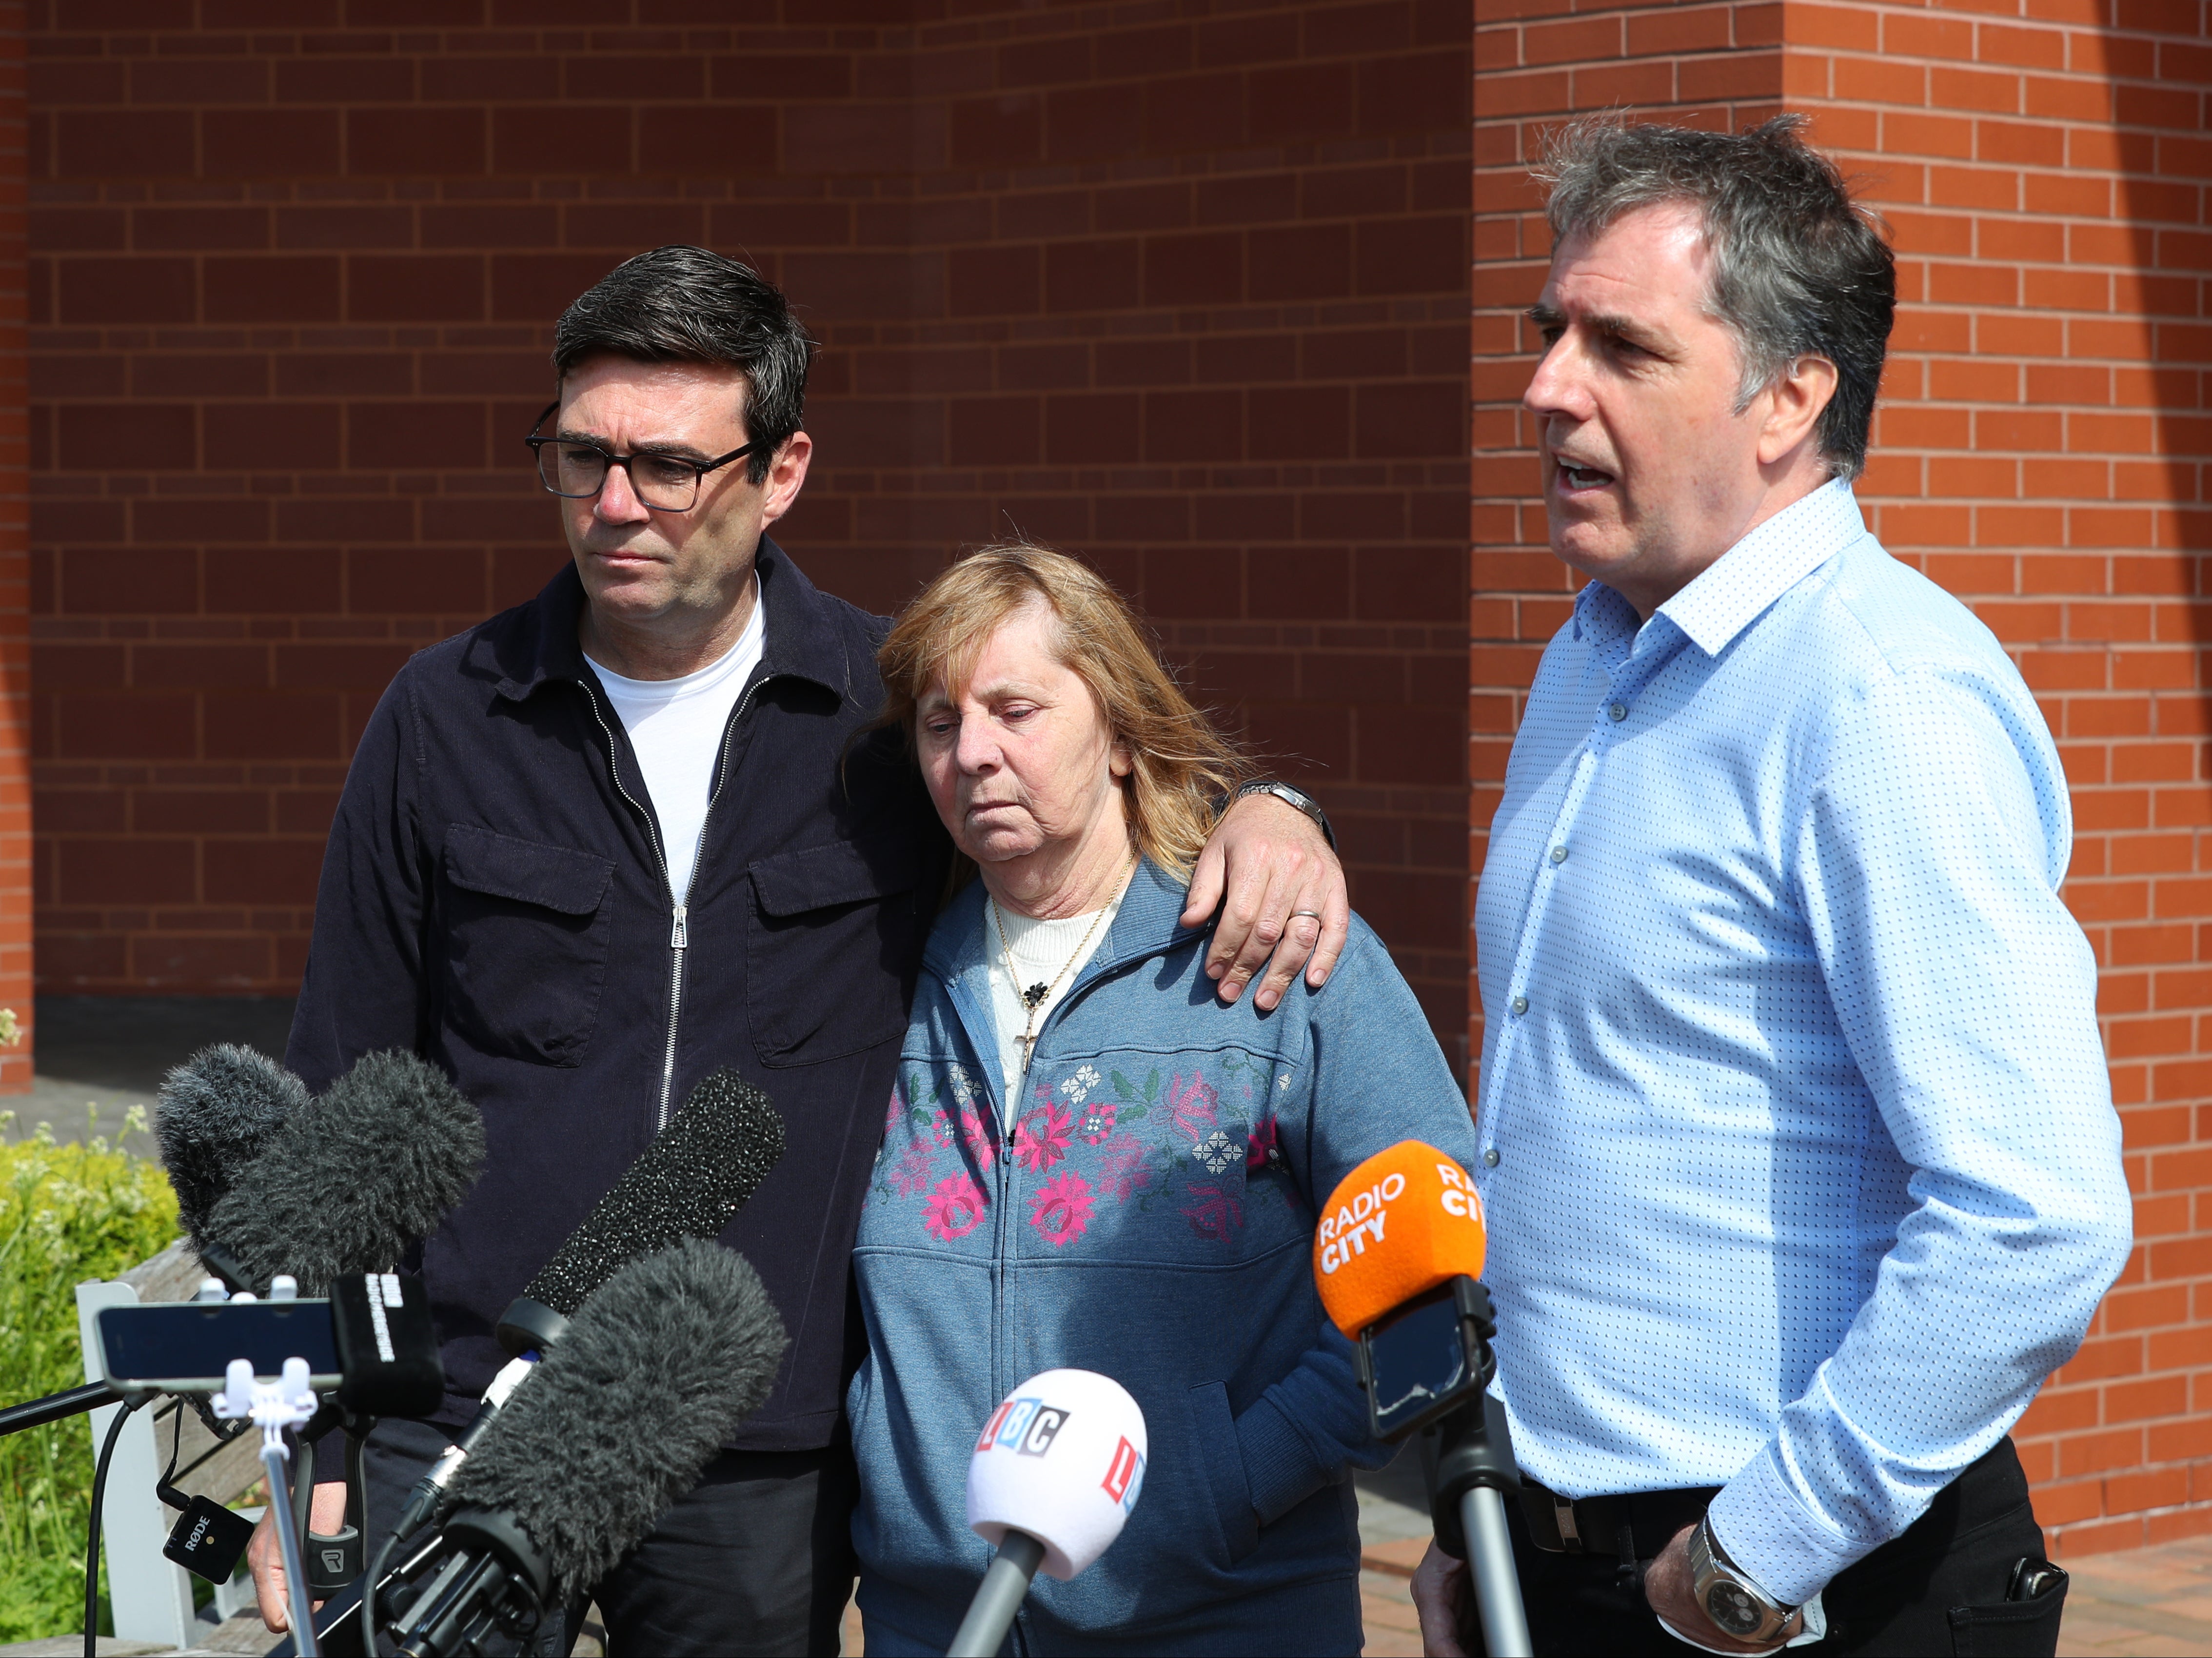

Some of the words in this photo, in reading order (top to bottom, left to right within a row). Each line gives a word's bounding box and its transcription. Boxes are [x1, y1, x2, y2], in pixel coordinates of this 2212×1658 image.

[1320, 1173, 1405, 1247] RADIO
[1321, 1210, 1386, 1275] CITY
[980, 1401, 1062, 1454] LBC
[185, 1516, 210, 1552] RØDE
